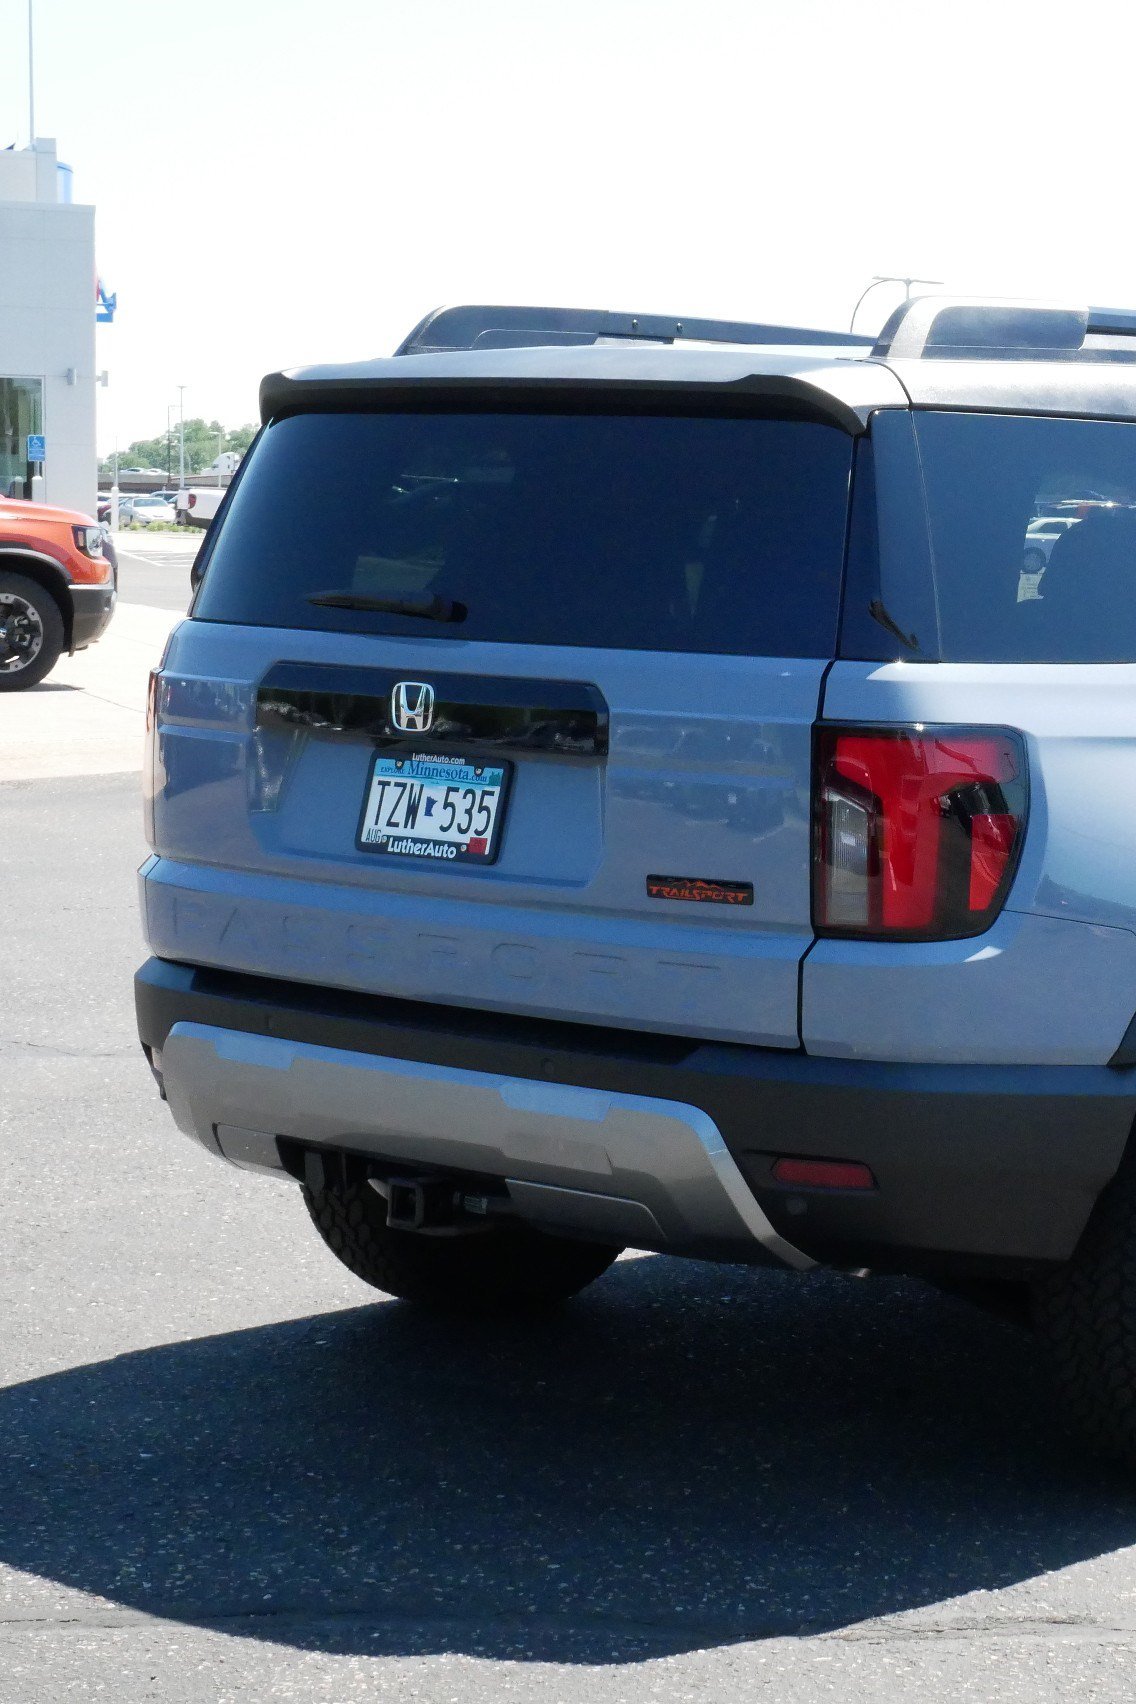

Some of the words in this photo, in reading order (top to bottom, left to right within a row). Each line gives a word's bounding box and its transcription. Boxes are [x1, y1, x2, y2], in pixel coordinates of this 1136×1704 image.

[411, 753, 466, 766] LutherAuto.com
[372, 779, 425, 830] TZW
[438, 786, 496, 837] 535
[365, 827, 382, 843] AUG
[387, 836, 457, 859] LutherAuto
[649, 885, 749, 904] TRAILSPORT
